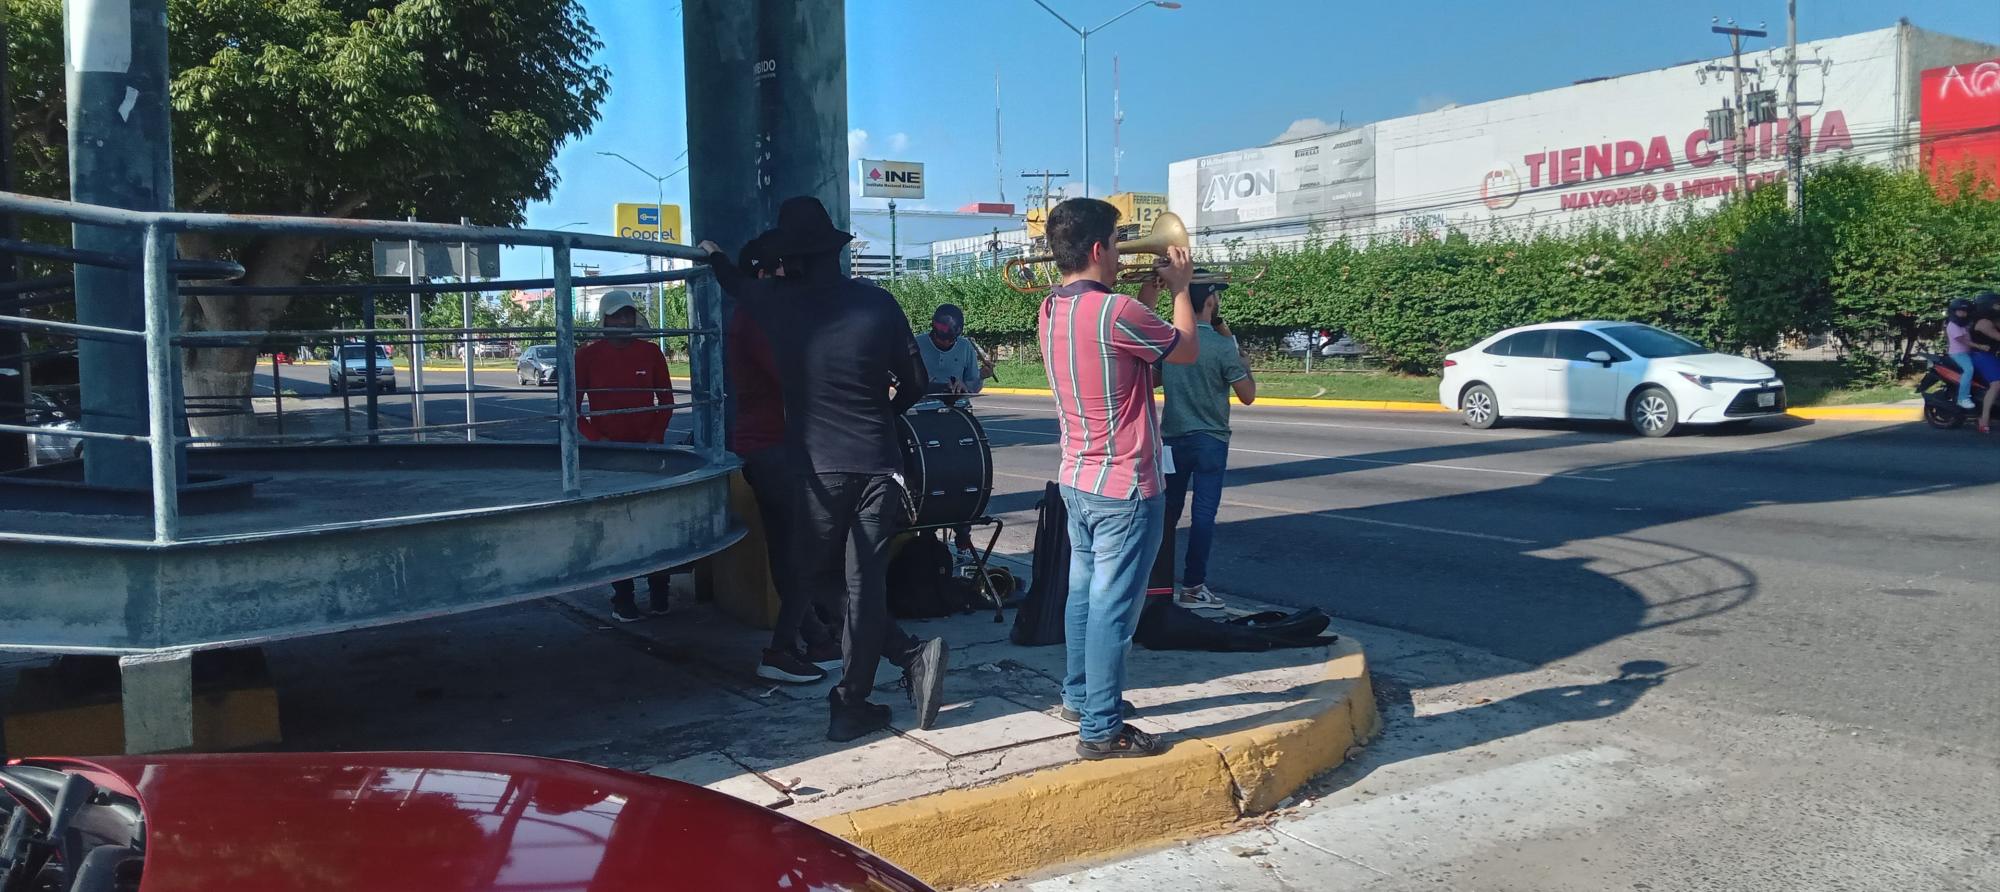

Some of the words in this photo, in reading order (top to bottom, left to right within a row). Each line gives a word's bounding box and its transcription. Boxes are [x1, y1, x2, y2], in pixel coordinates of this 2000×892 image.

[1524, 136, 1675, 188] TIENDA
[885, 170, 920, 184] INE
[1202, 168, 1276, 211] AYON
[1560, 183, 1657, 210] MAYOREO
[1662, 183, 1678, 201] &
[621, 226, 676, 241] Coppel
